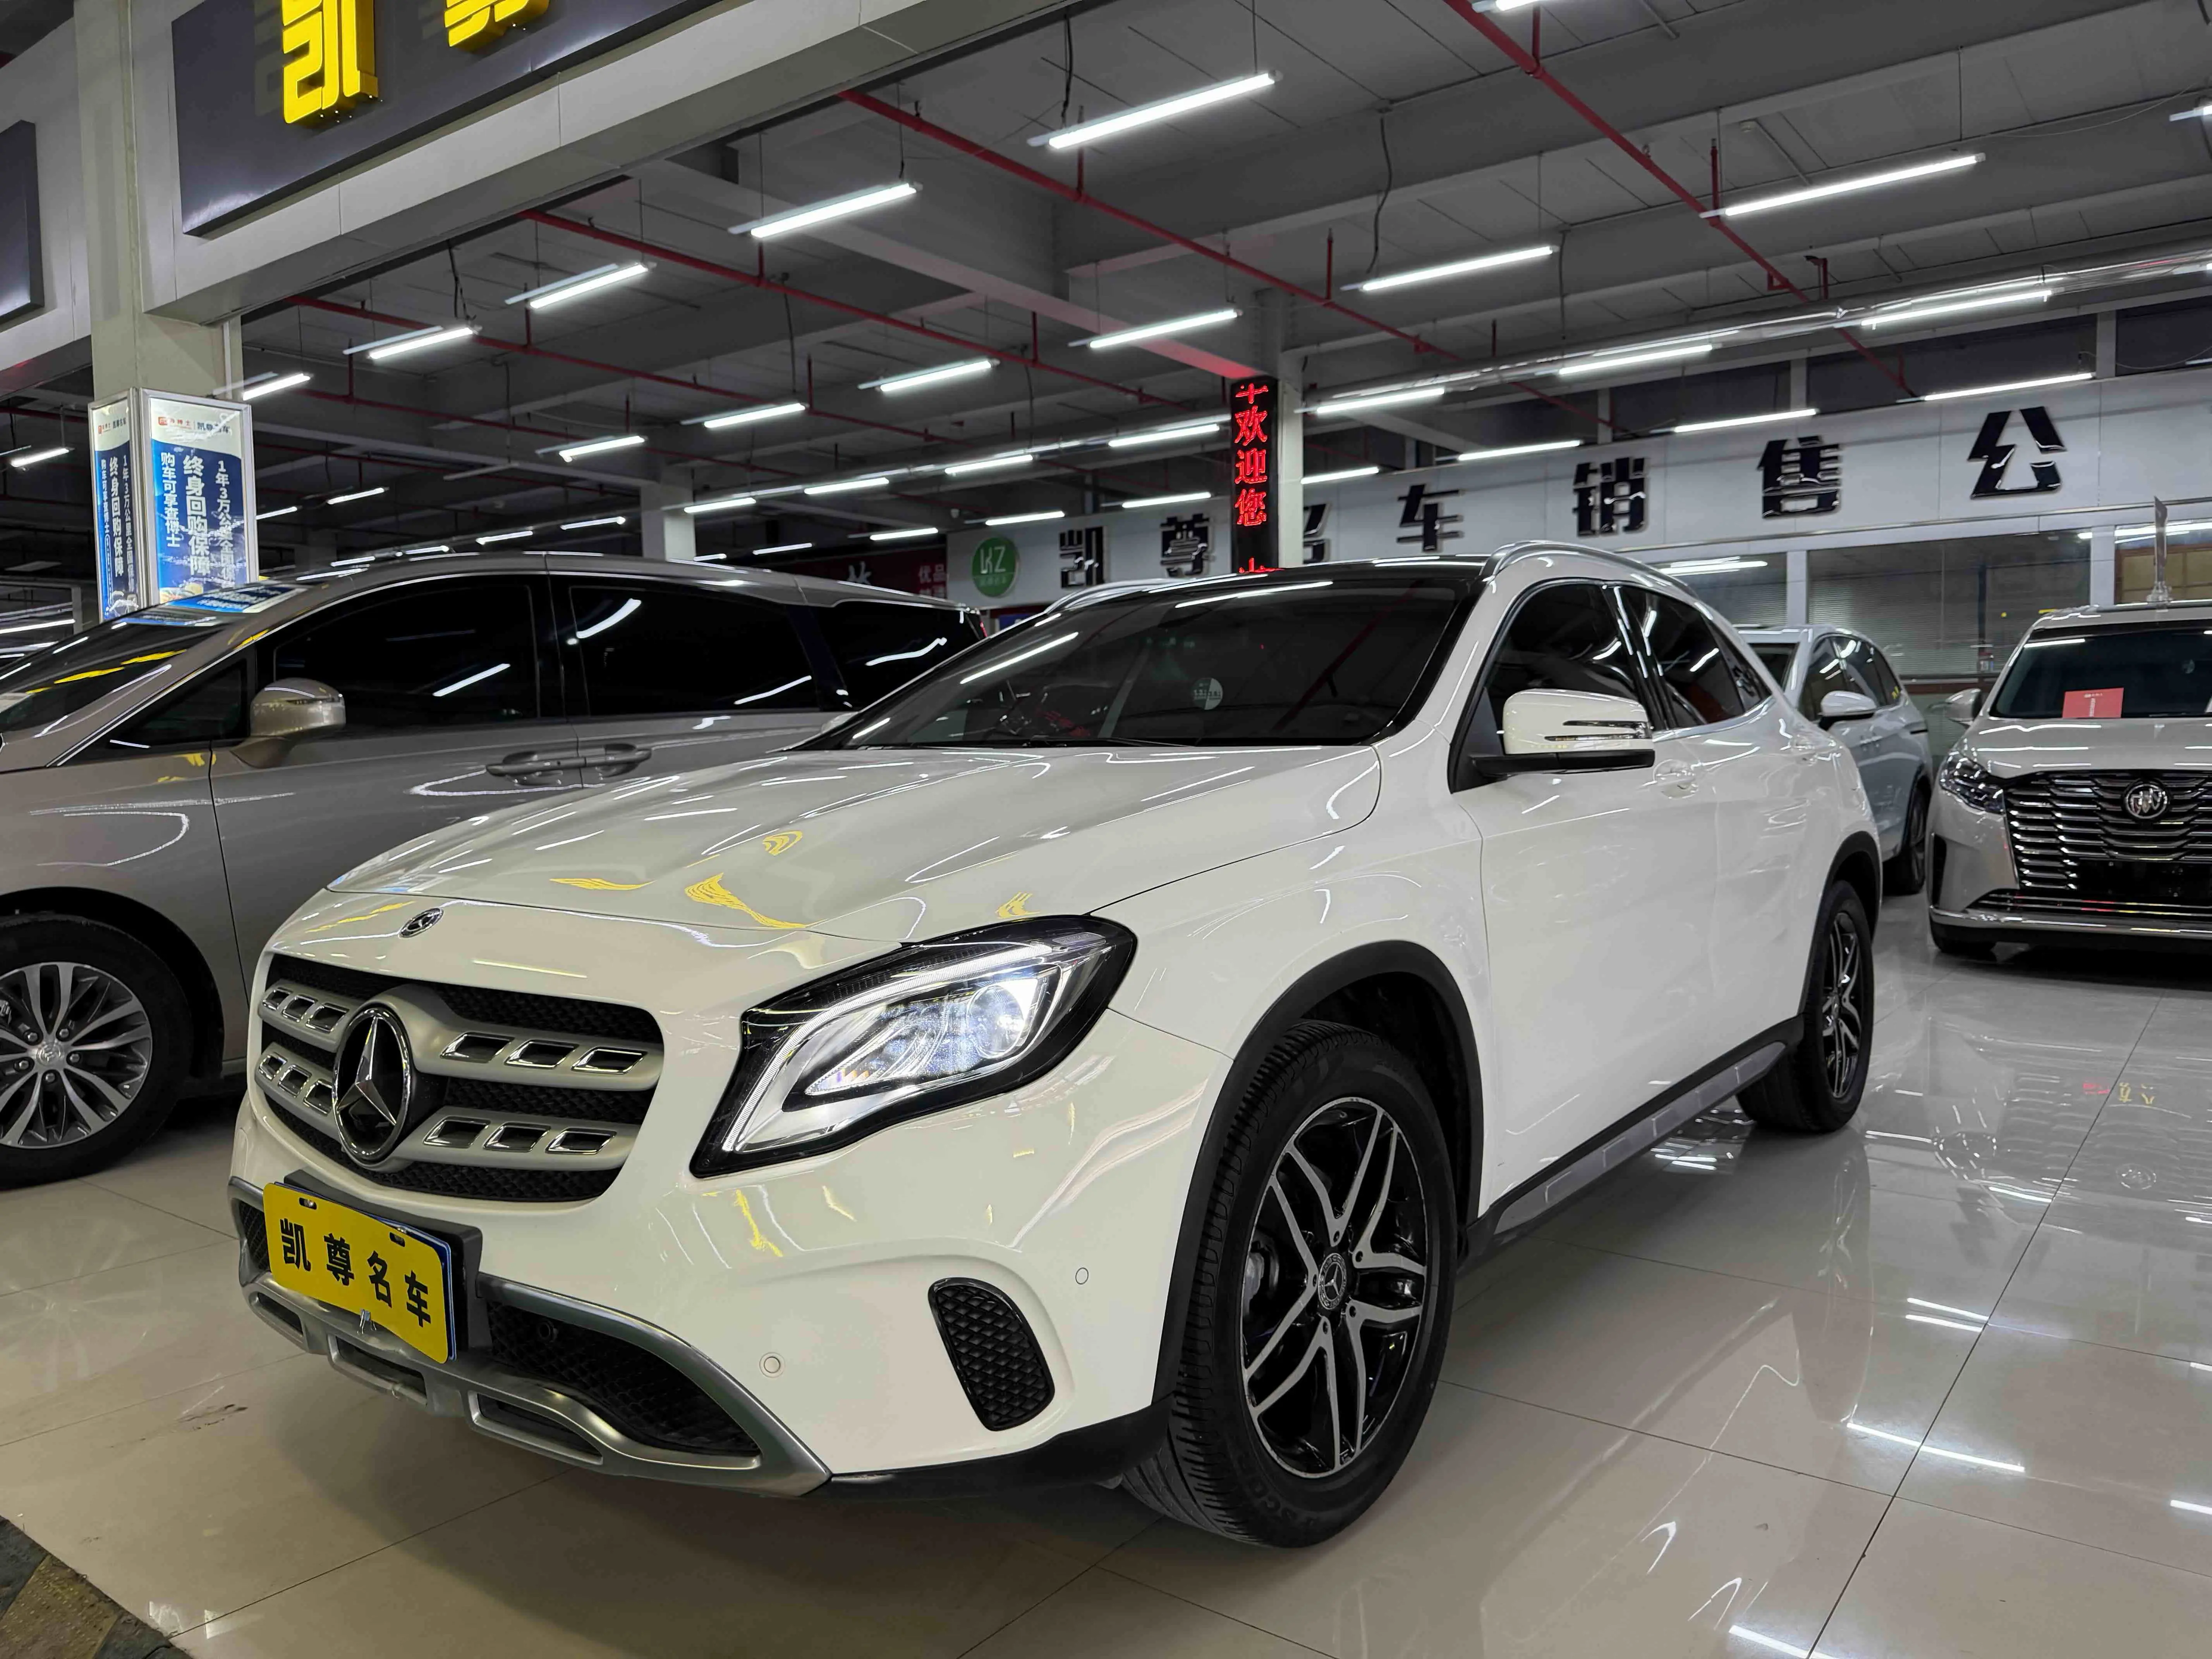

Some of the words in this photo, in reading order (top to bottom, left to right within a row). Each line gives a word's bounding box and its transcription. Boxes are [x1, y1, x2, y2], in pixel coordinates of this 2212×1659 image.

[110, 456, 124, 577] 终身回购保障
[161, 452, 180, 547] 购车可享查博士
[183, 455, 211, 576] 终身回购保障
[279, 1218, 431, 1328] 凯尊名车
